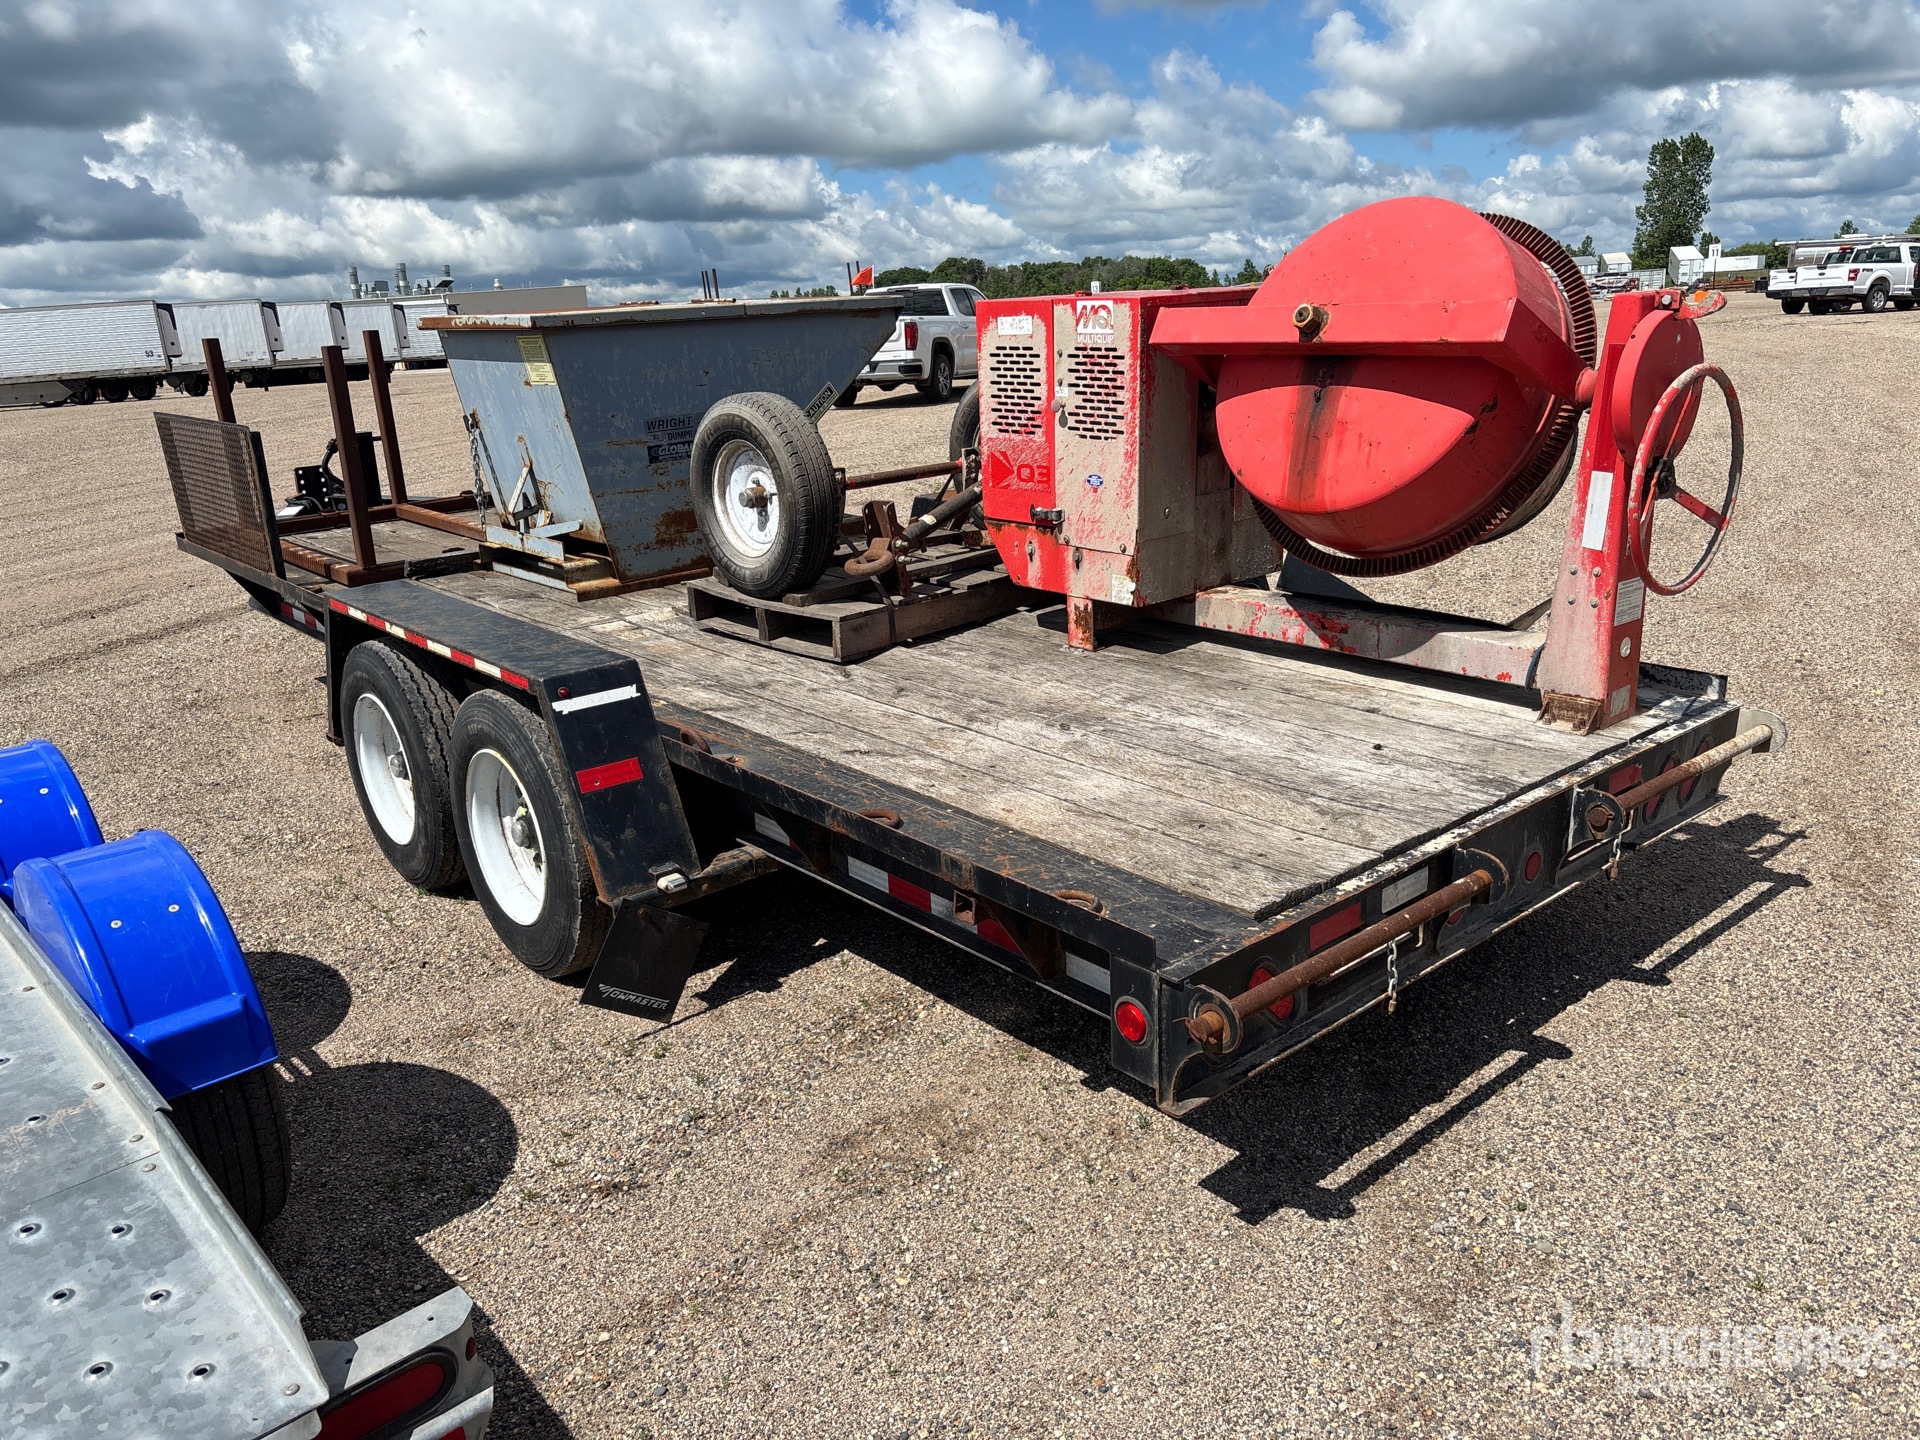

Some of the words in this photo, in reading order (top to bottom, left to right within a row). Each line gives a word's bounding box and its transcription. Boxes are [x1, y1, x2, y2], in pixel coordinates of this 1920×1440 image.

[1092, 285, 1099, 293] 13
[1077, 334, 1114, 344] MULTIQUIP
[646, 416, 692, 431] WRIGHT
[598, 984, 670, 1010] TOWMASTER
